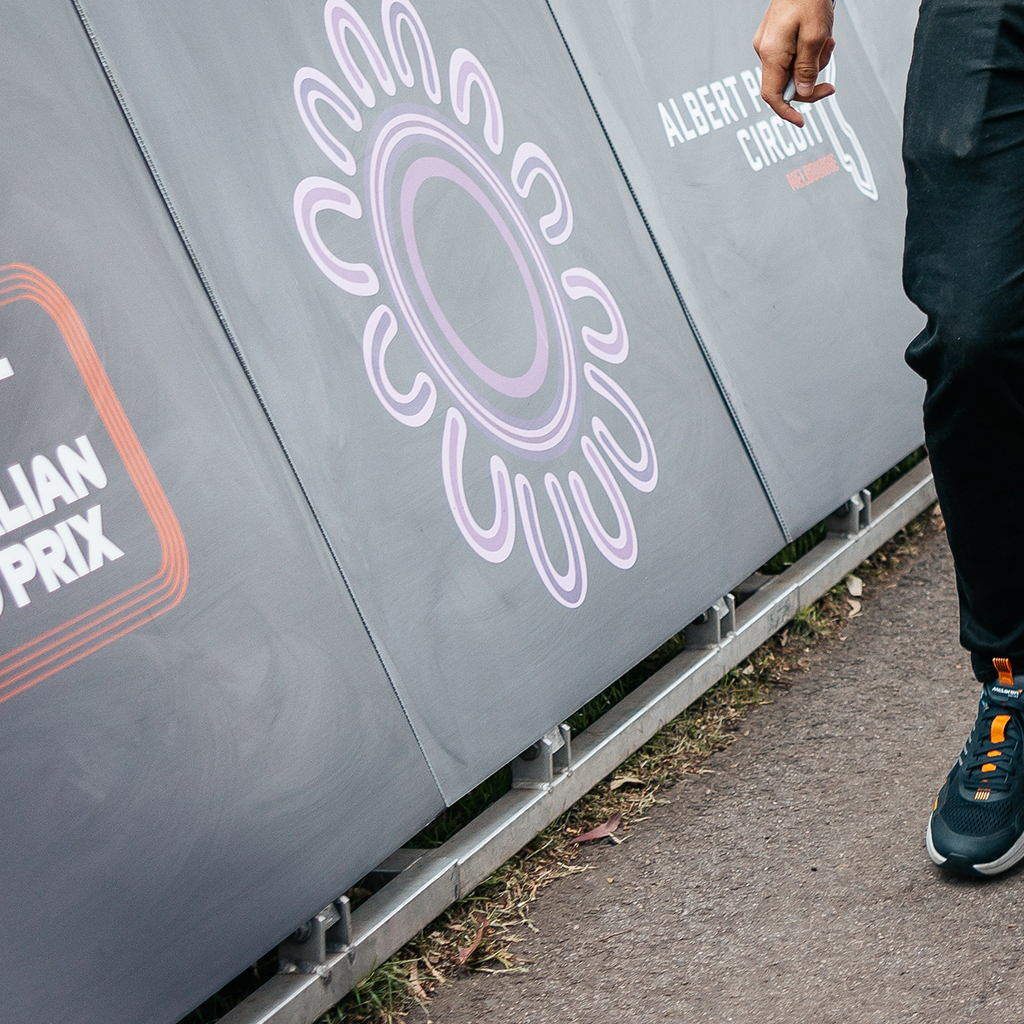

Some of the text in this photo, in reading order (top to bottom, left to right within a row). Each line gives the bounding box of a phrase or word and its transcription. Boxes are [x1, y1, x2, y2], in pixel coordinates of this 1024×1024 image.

[657, 75, 749, 148] ALBERT
[0, 434, 108, 536] LIAN
[0, 504, 126, 608] PRIX
